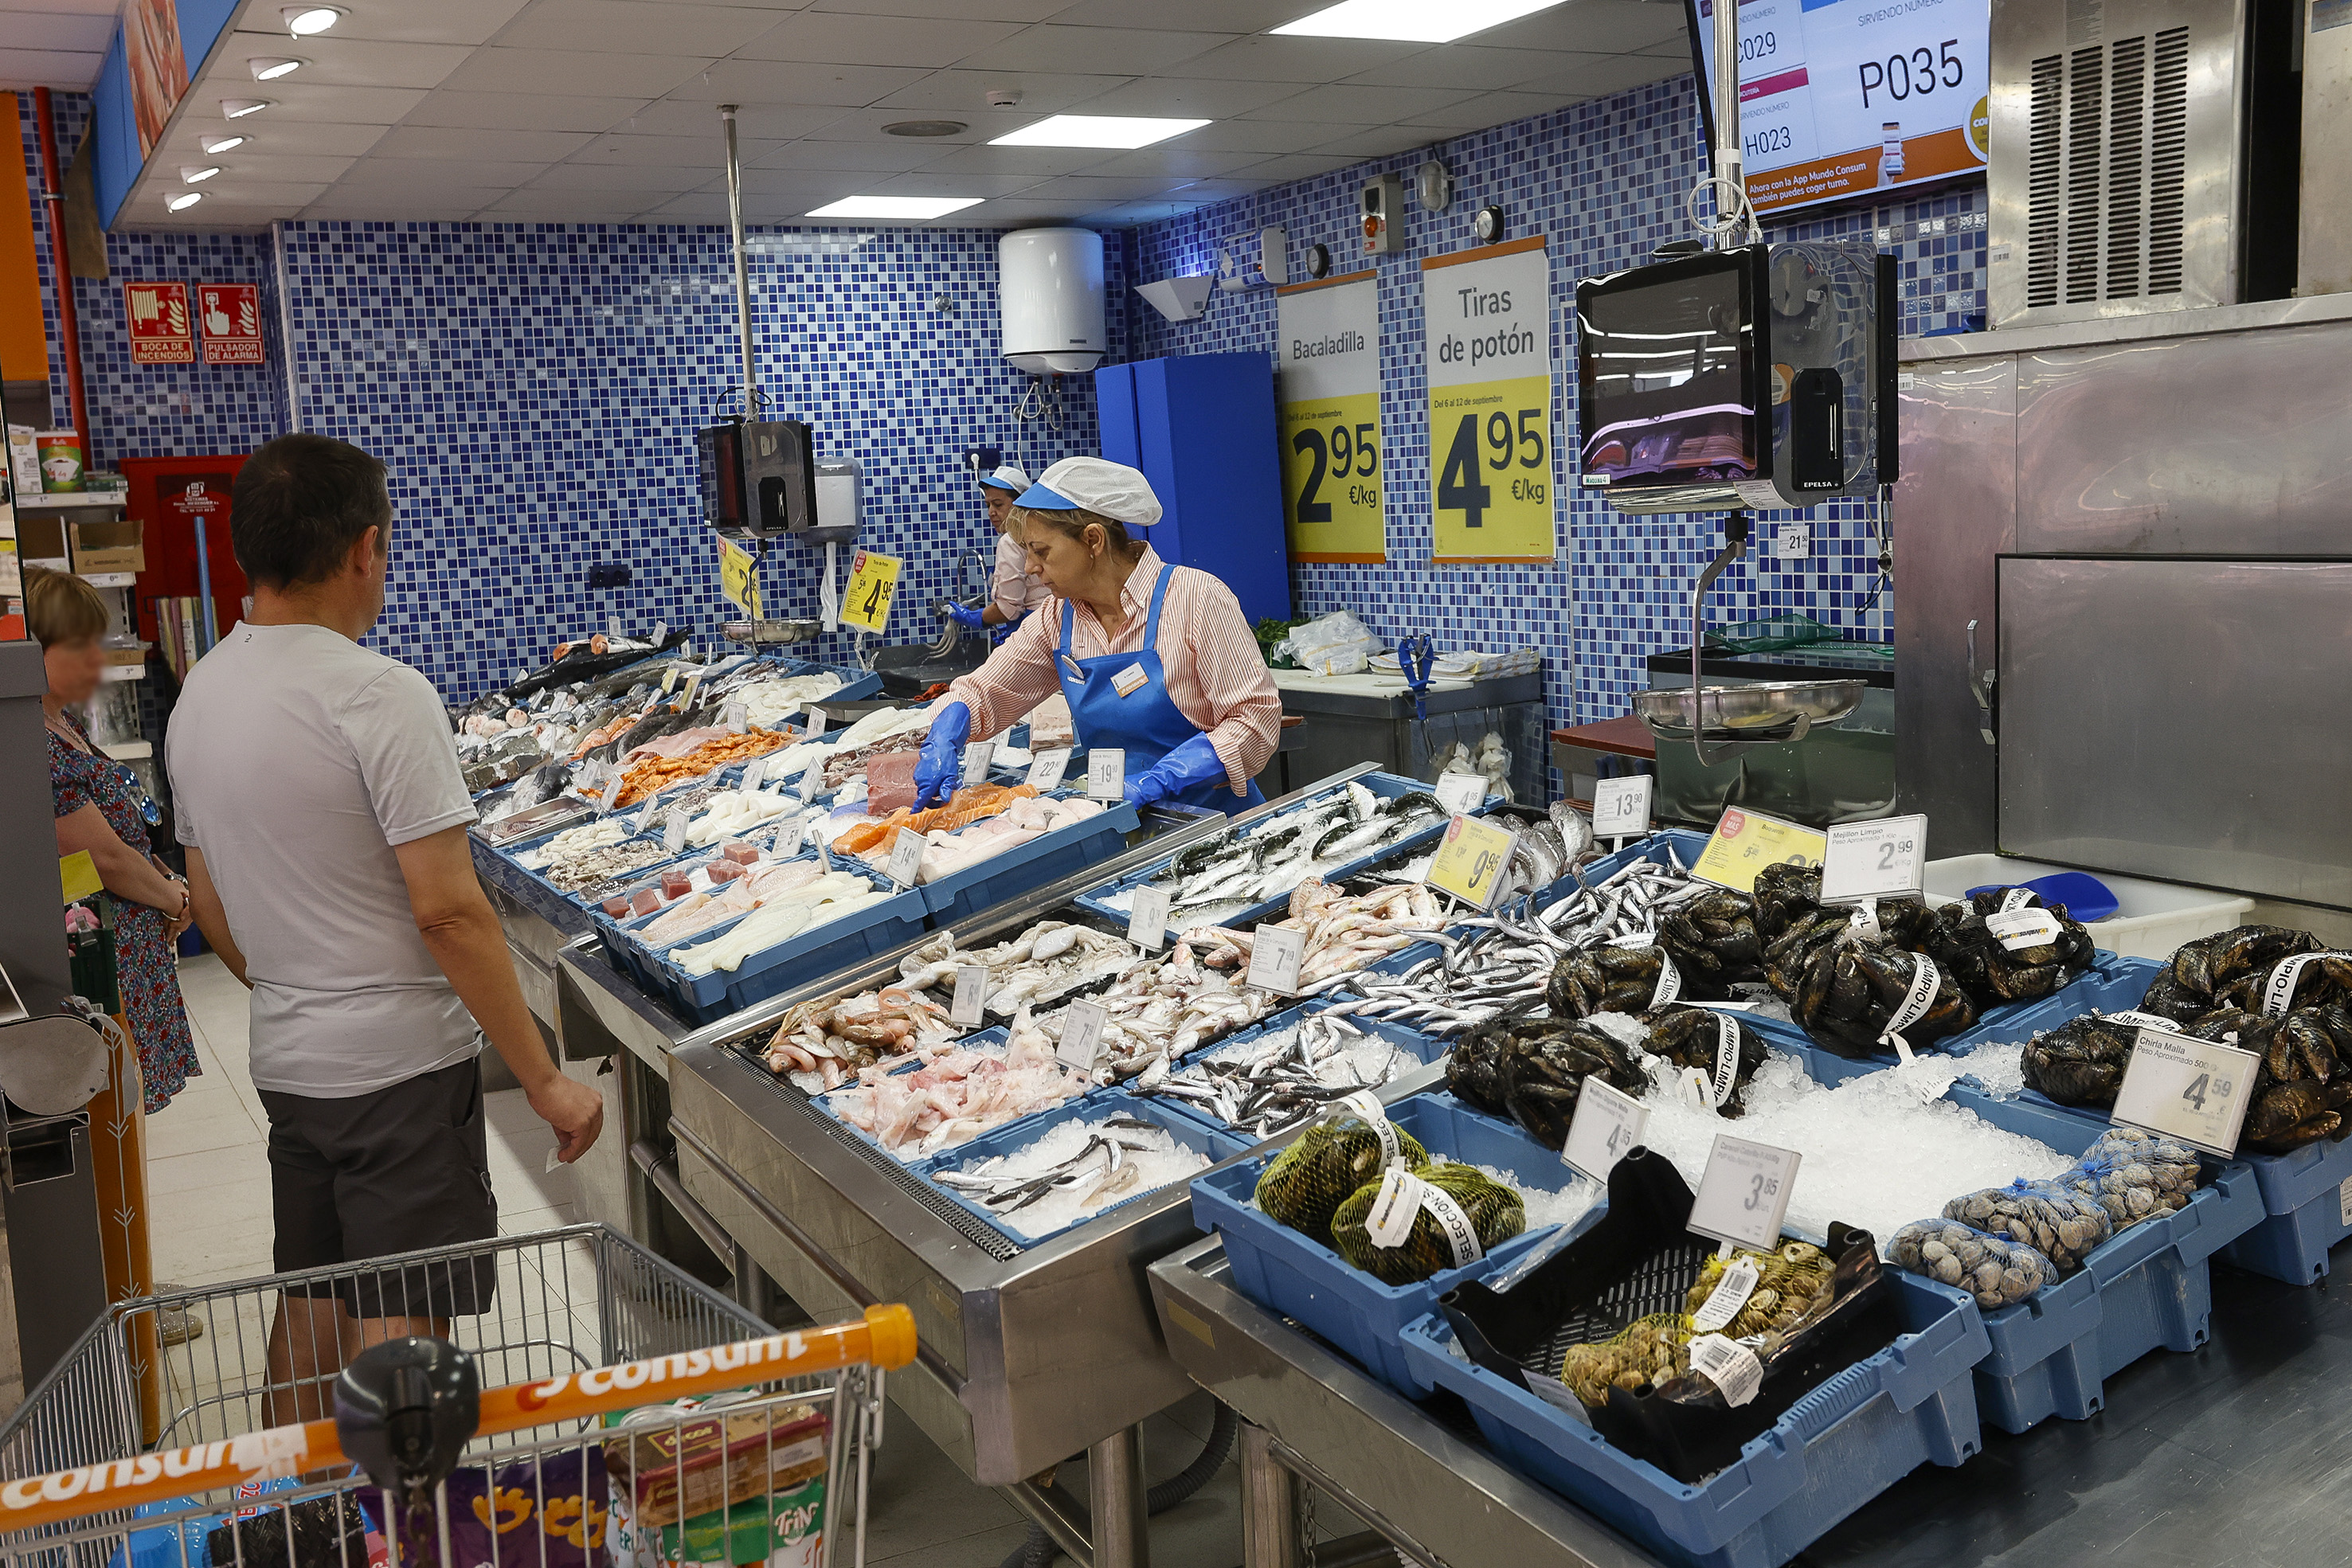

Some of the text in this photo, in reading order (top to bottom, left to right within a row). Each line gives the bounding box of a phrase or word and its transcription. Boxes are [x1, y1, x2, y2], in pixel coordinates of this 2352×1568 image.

[1857, 4, 1904, 27] SIRVIENDO
[1859, 39, 1963, 109] P035
[1745, 125, 1792, 157] H023
[1749, 162, 1867, 194] Ahora con la App Mundo Consum
[1751, 178, 1850, 205] también puedes coger turno.
[1458, 287, 1513, 319] Tiras
[137, 351, 190, 360] INCENDIOS
[141, 342, 184, 351] BOCA DE
[208, 343, 258, 352] PULSADOR
[209, 351, 260, 360] DE ALARMA
[1292, 330, 1365, 361] Bacaladilla
[1439, 323, 1534, 366] de potón
[1434, 394, 1504, 409] Del 6 al 12 de septiembre
[1348, 485, 1377, 509] €/kg
[1511, 478, 1545, 506] €/kg
[1789, 534, 1800, 549] 21
[1039, 761, 1055, 778] 22
[1100, 764, 1112, 783] 19
[1615, 793, 1634, 816] 13
[1877, 842, 1896, 871] 2
[1468, 850, 1489, 889] 9
[2136, 1045, 2154, 1056] Peso
[2153, 1050, 2194, 1066] Aproximado
[2194, 1059, 2209, 1069] 500
[2139, 1036, 2186, 1054] Chirla Malla
[2182, 1072, 2211, 1111] 4
[1743, 1173, 1764, 1211] 3
[577, 1331, 809, 1397] consum
